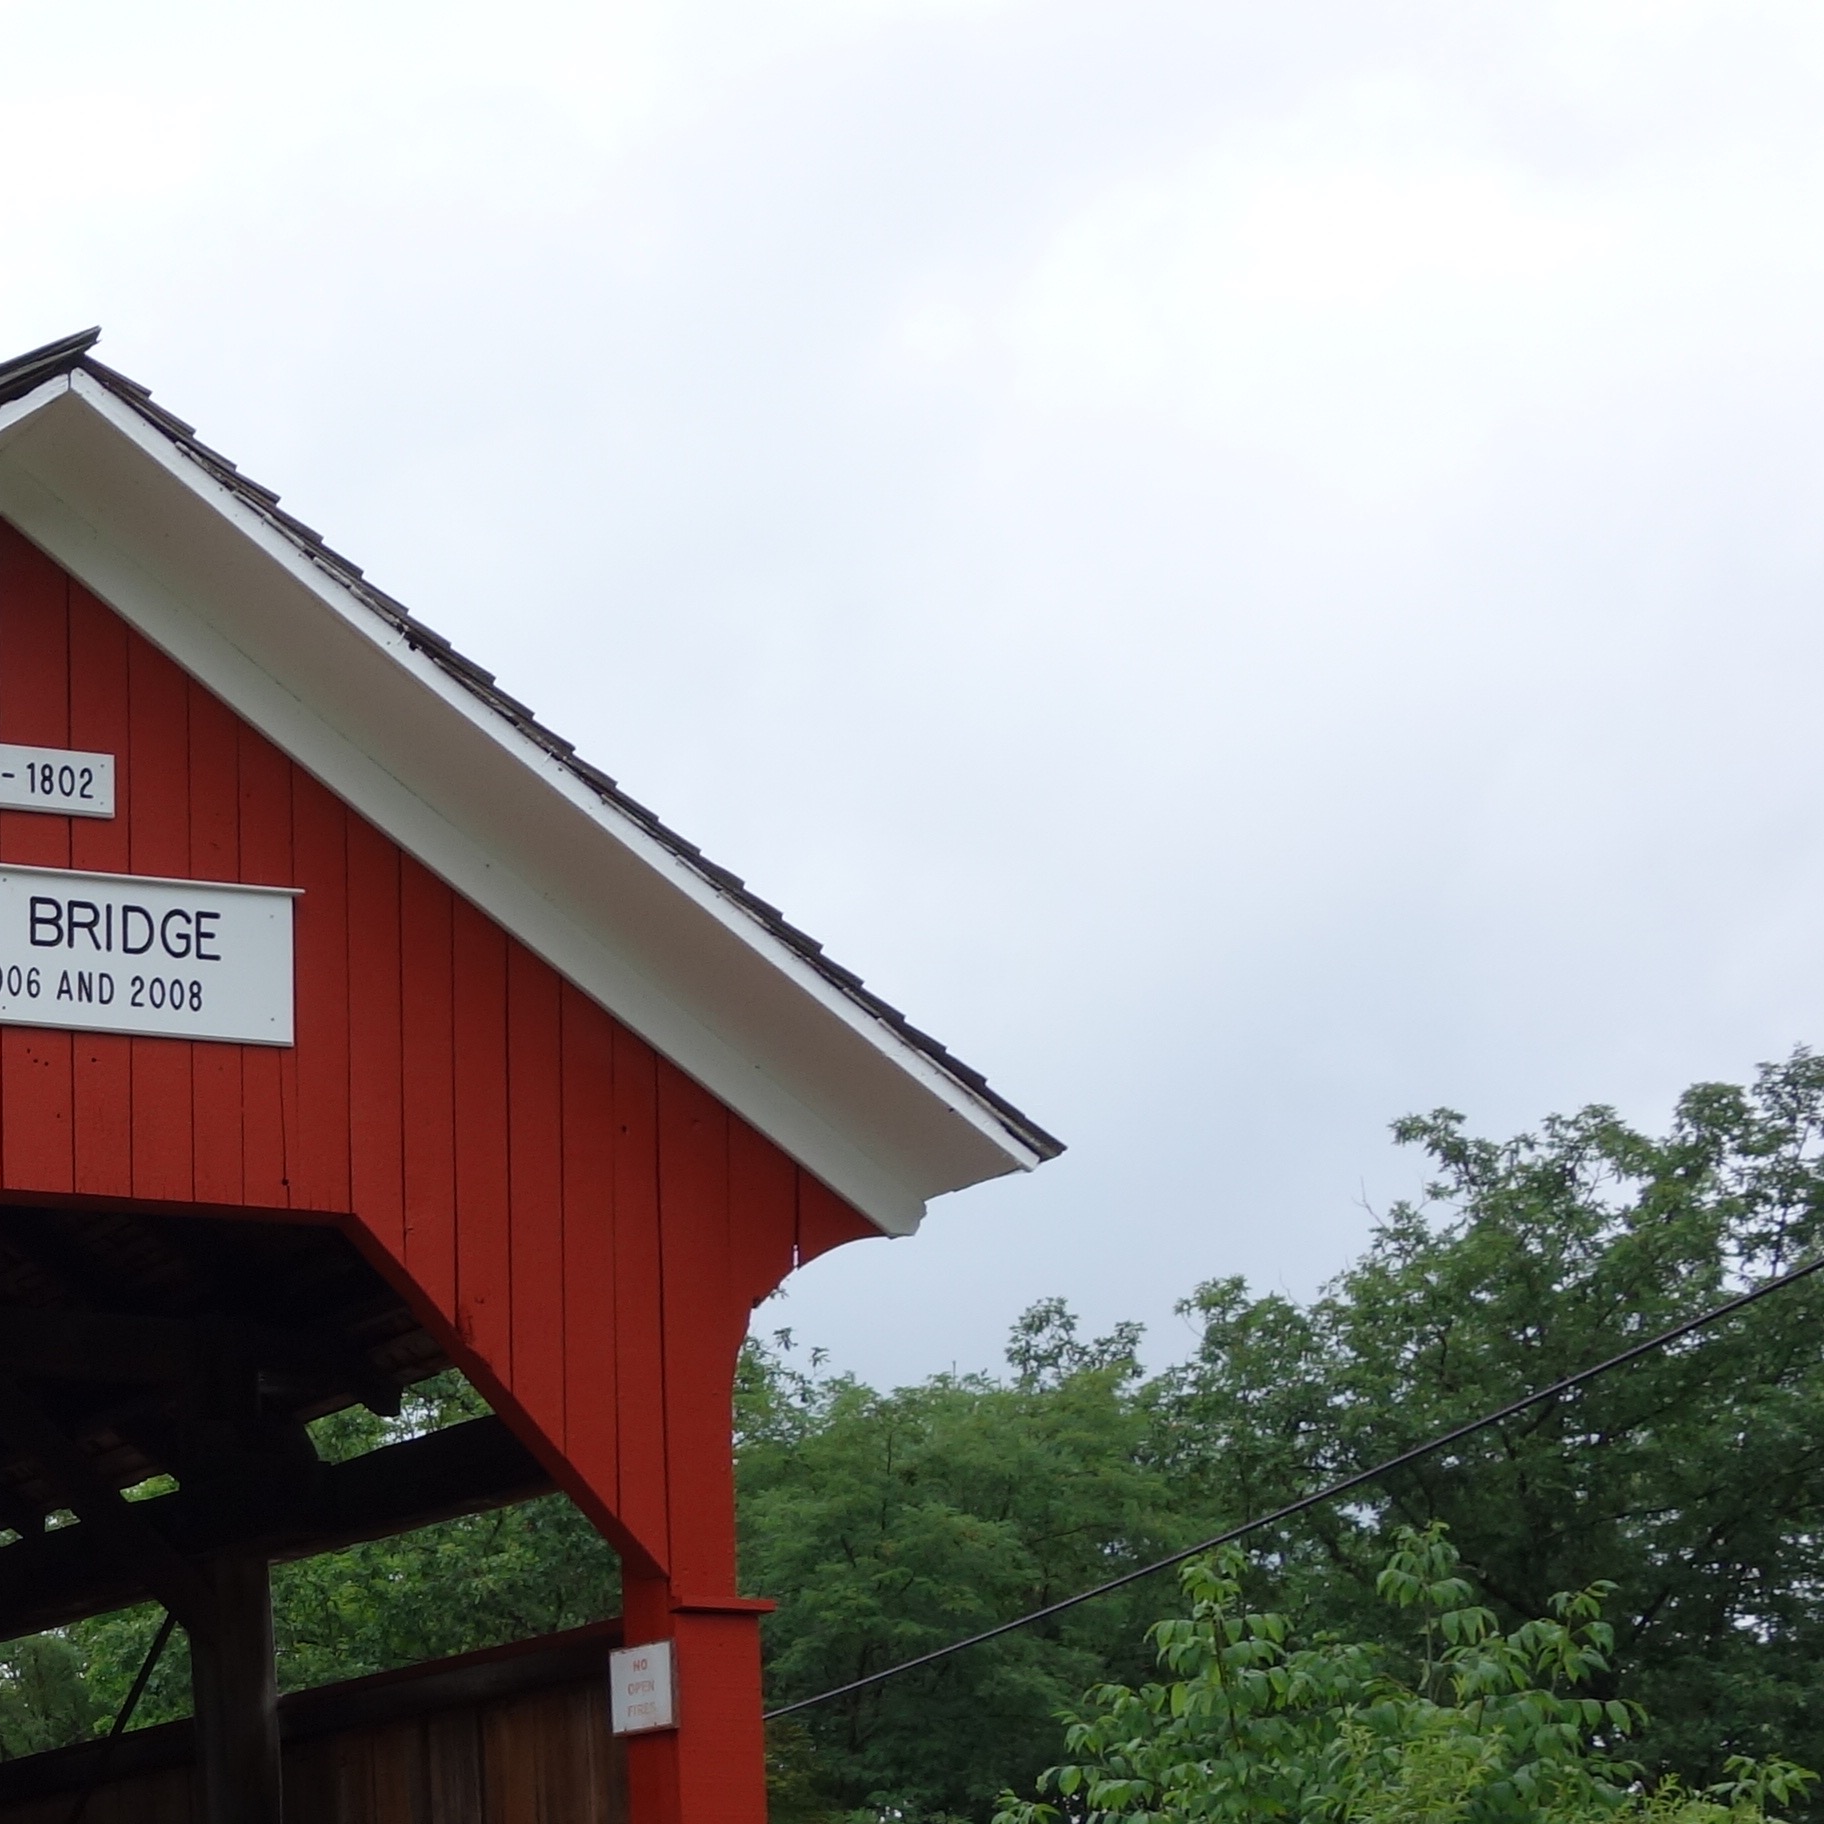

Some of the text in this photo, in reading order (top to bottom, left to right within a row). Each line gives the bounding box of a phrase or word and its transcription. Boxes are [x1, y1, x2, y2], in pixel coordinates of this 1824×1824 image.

[26, 762, 94, 800] 1802
[29, 895, 222, 962] BRIDGE
[56, 969, 115, 1005] AND
[130, 975, 203, 1012] 2008
[633, 1659, 648, 1672] NO
[628, 1681, 655, 1696] OPEN
[628, 1702, 656, 1717] FIRES
